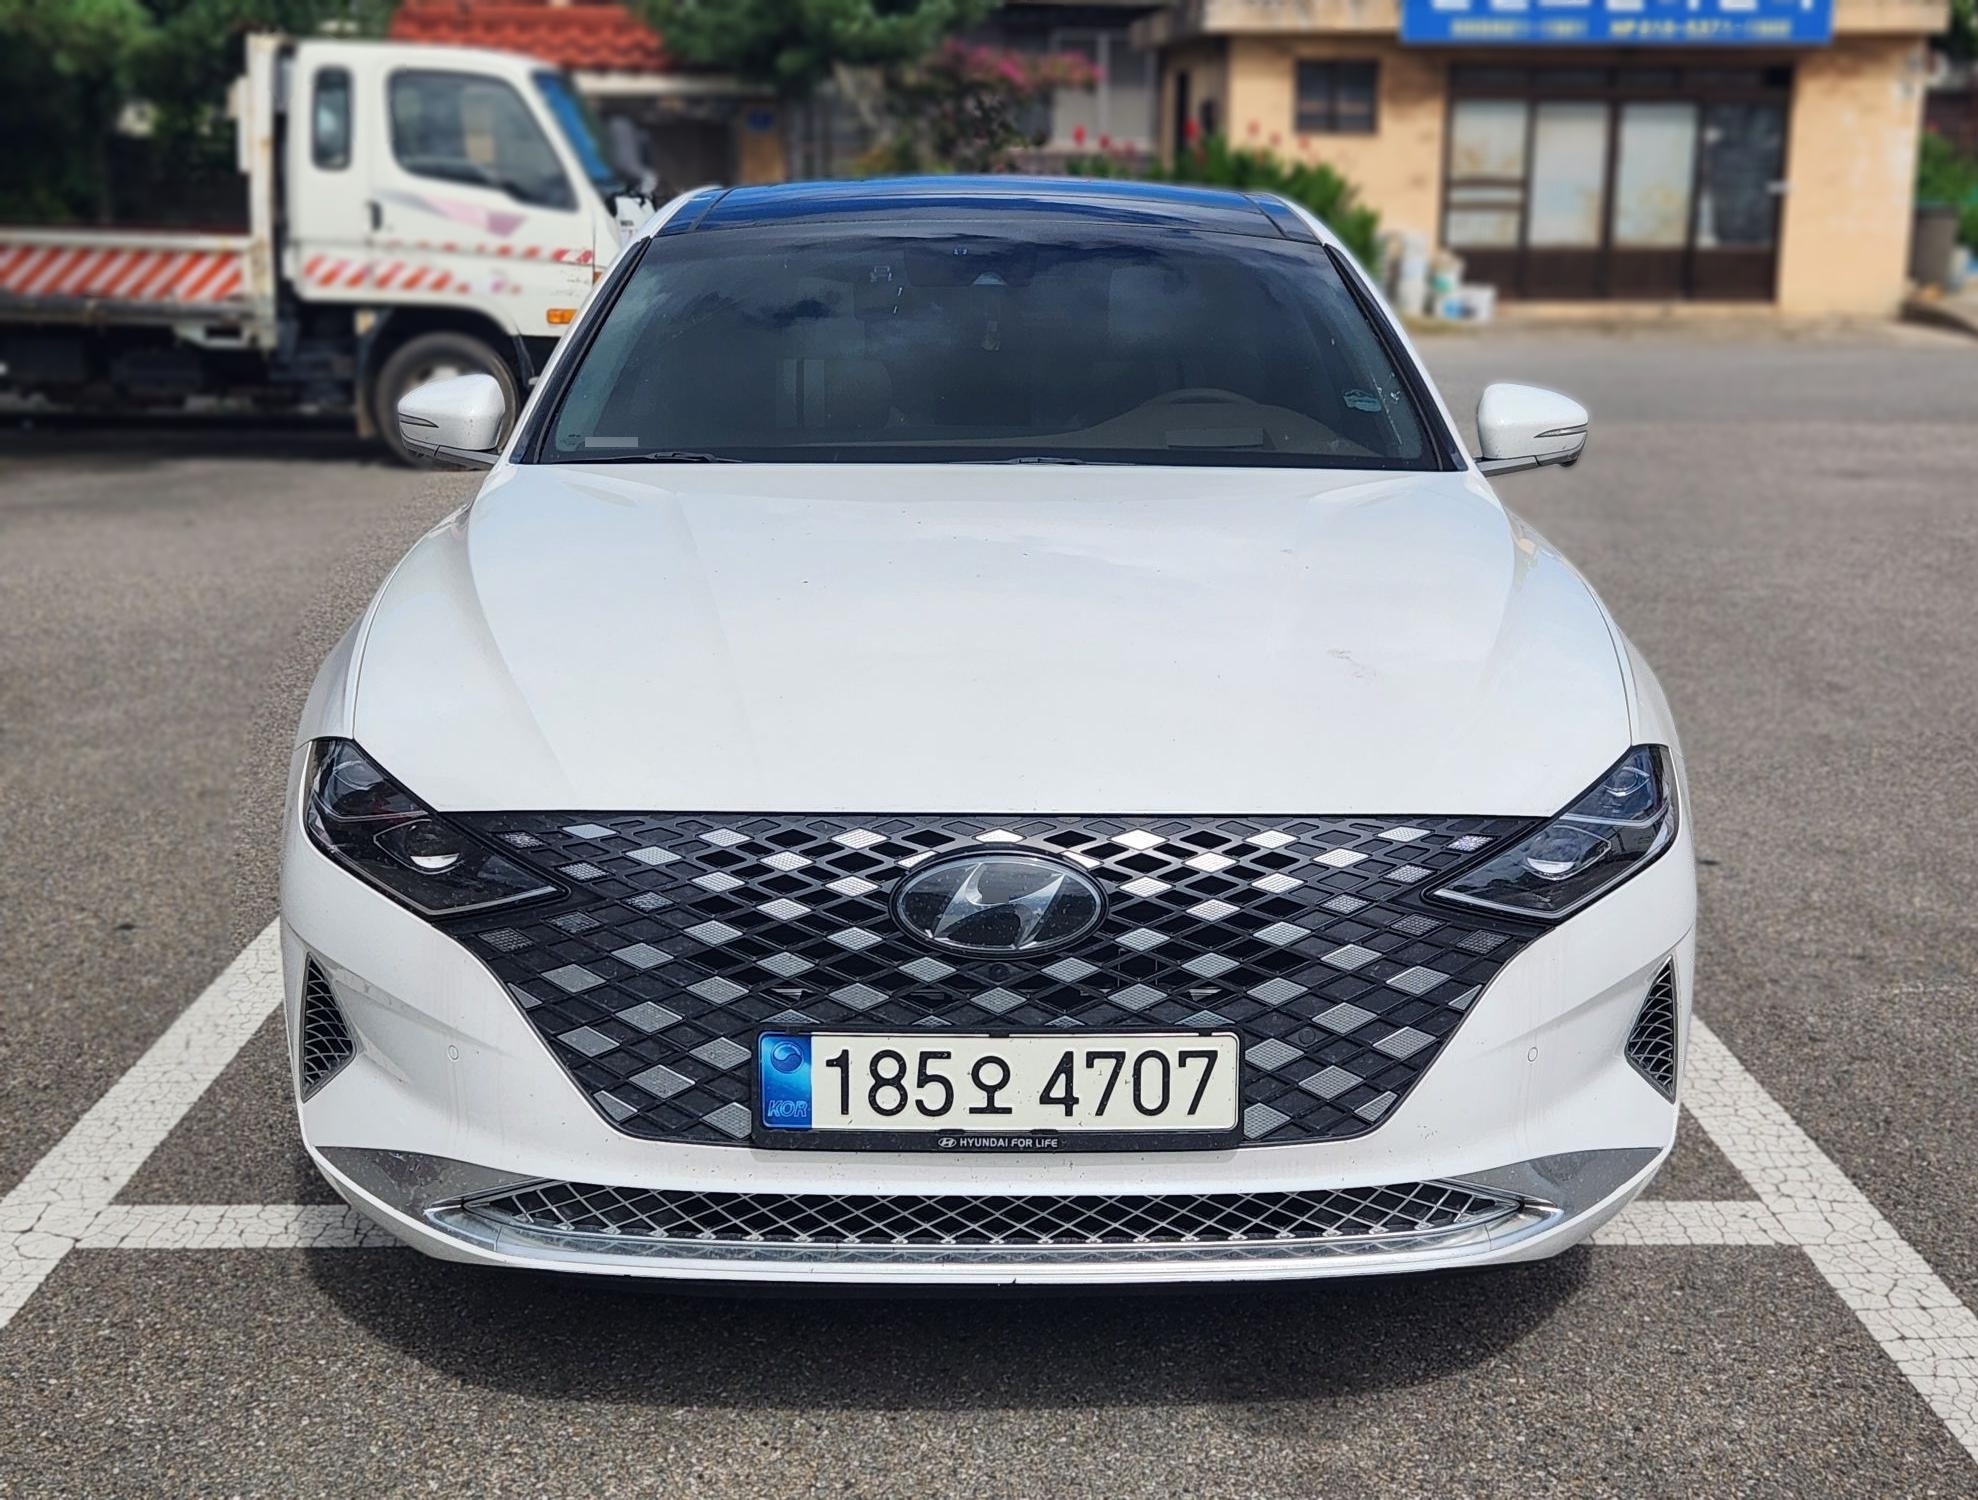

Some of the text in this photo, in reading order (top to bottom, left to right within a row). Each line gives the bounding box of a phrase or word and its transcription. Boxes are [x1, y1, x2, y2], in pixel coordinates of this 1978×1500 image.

[825, 1049, 1218, 1117] 185오 4707
[768, 1100, 807, 1117] KOR
[960, 1137, 1058, 1148] HYUNDAI FOR LIFE
